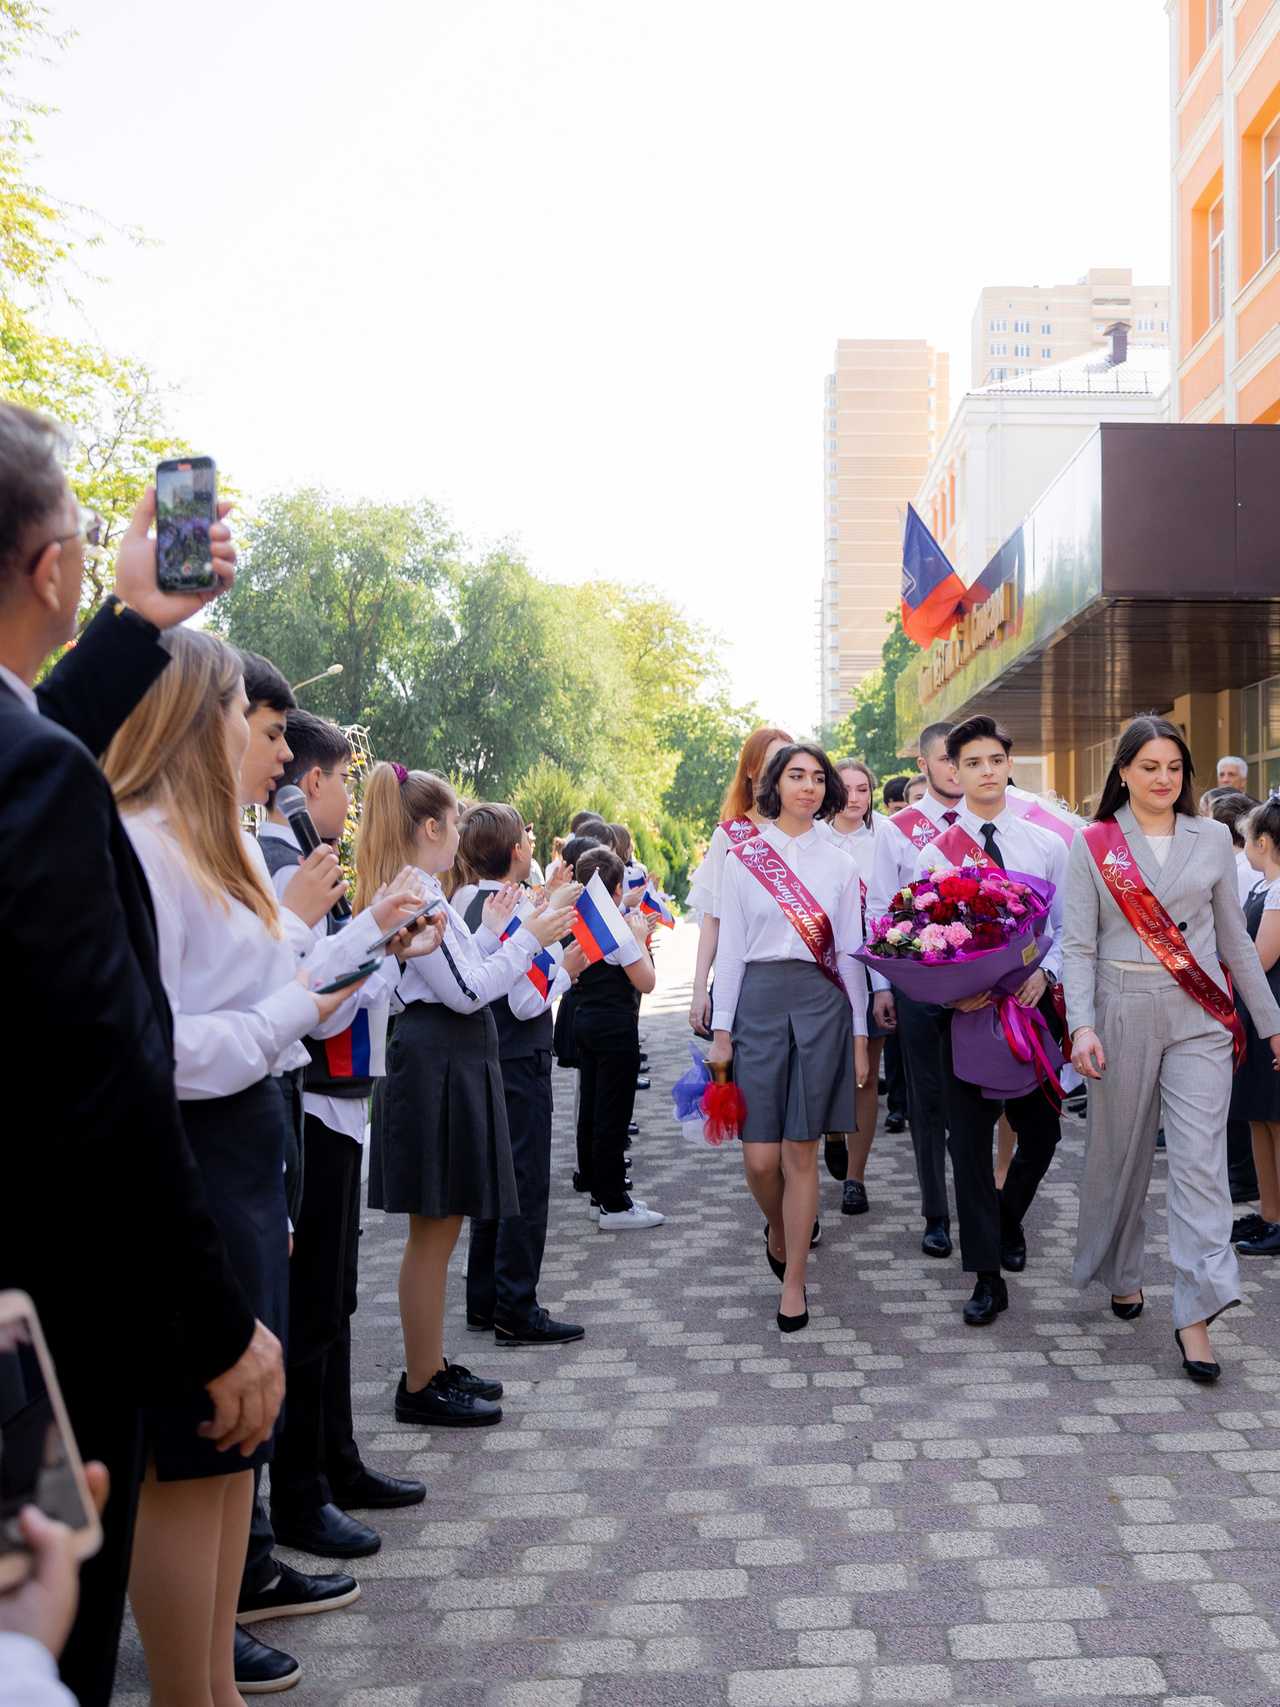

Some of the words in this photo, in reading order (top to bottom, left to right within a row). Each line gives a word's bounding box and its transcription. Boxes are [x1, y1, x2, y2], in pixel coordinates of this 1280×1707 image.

[758, 859, 824, 946] Выпускница
[1115, 879, 1158, 930] Классный
[1149, 930, 1207, 990] руководитель
[1205, 990, 1230, 1016] 2022
